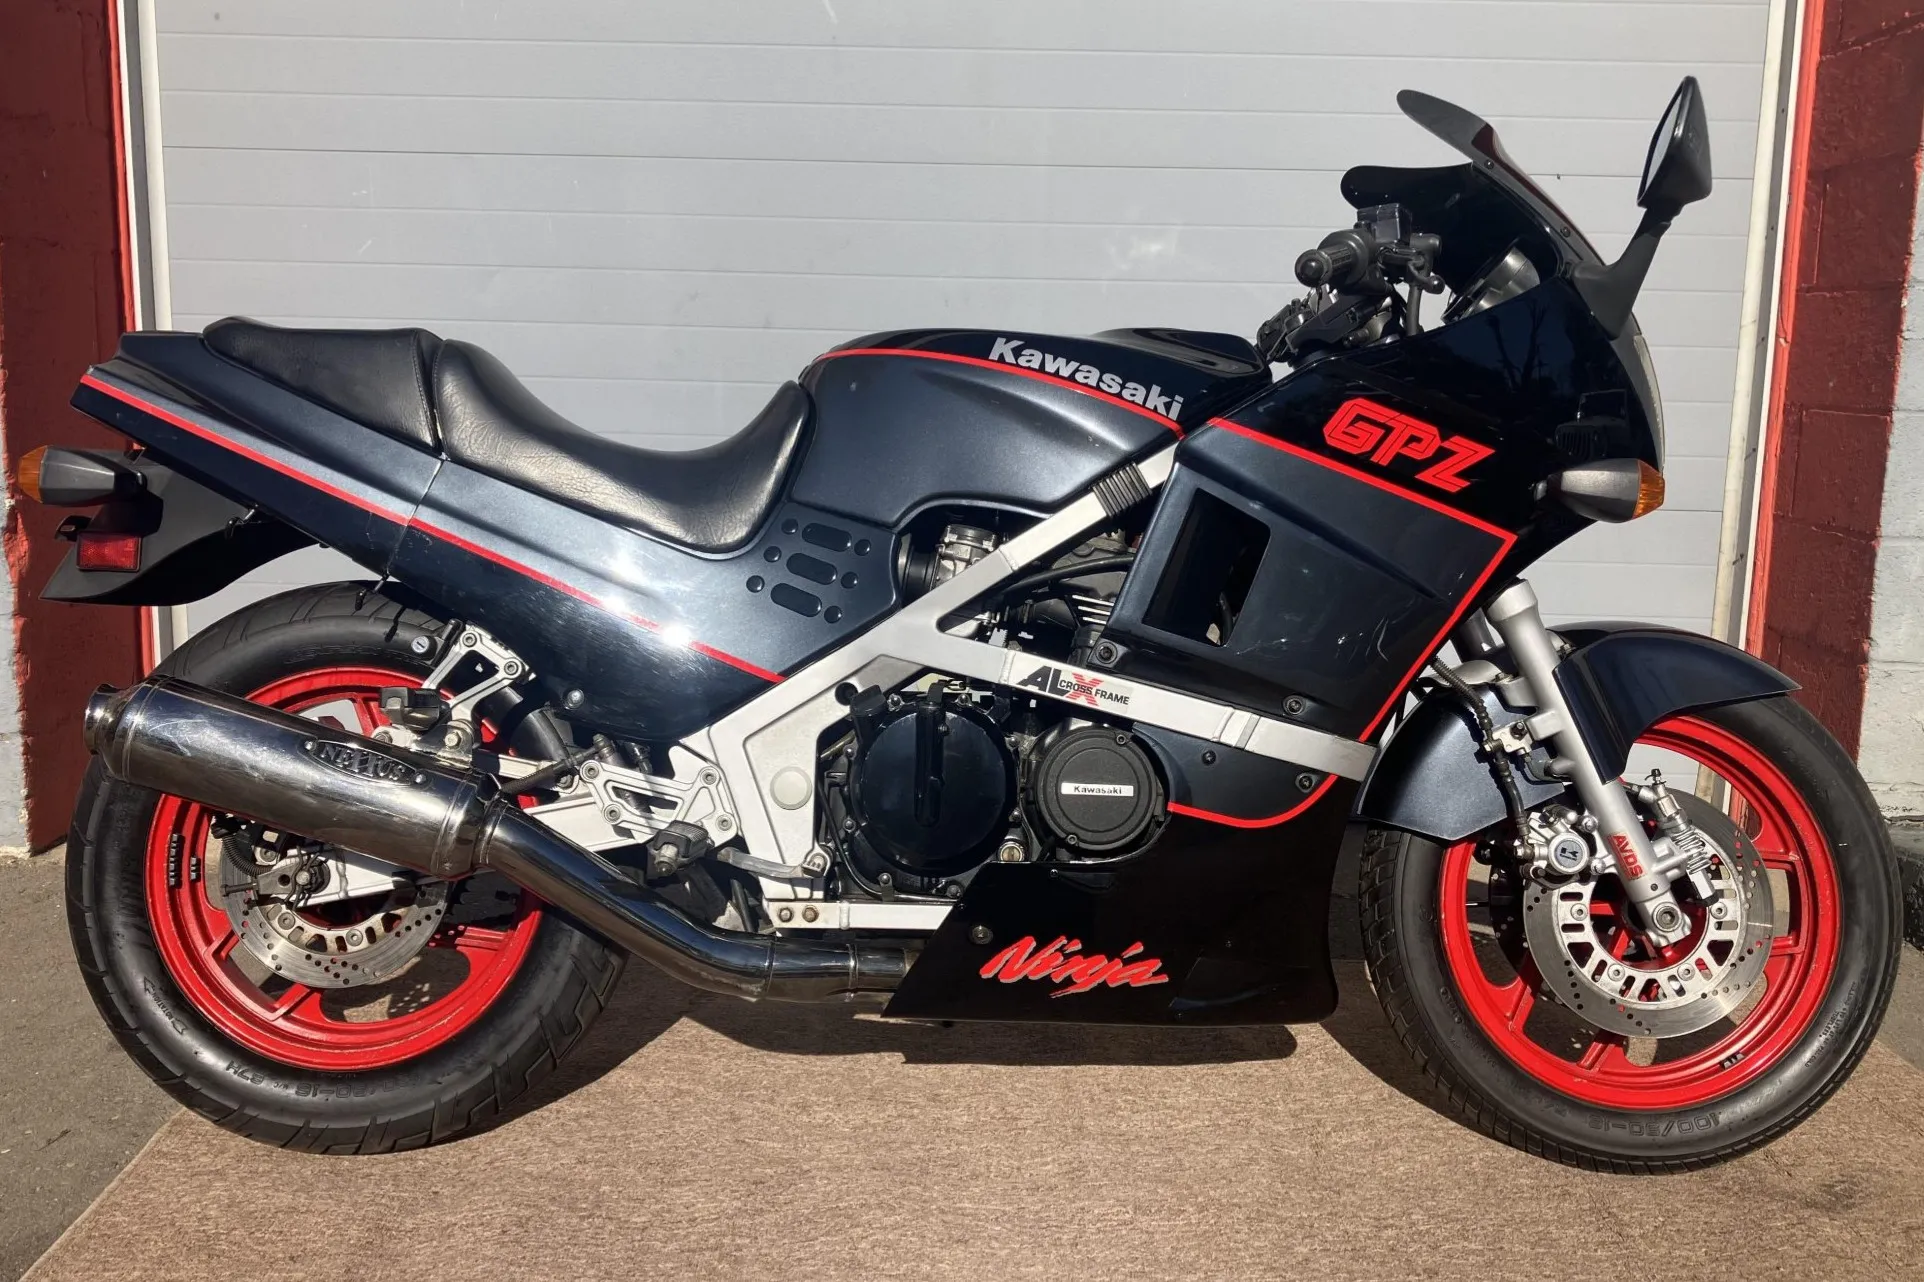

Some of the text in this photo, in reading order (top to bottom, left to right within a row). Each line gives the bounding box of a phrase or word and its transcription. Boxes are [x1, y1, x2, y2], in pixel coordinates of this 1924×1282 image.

[988, 337, 1184, 420] Kawasaki
[1323, 397, 1496, 493] GPZ
[1059, 679, 1130, 705] CROSS FRAME
[1074, 785, 1122, 794] Kawasaki
[1612, 835, 1643, 877] AVDS
[979, 936, 1169, 998] Ninja
[151, 991, 173, 1021] ROTATION
